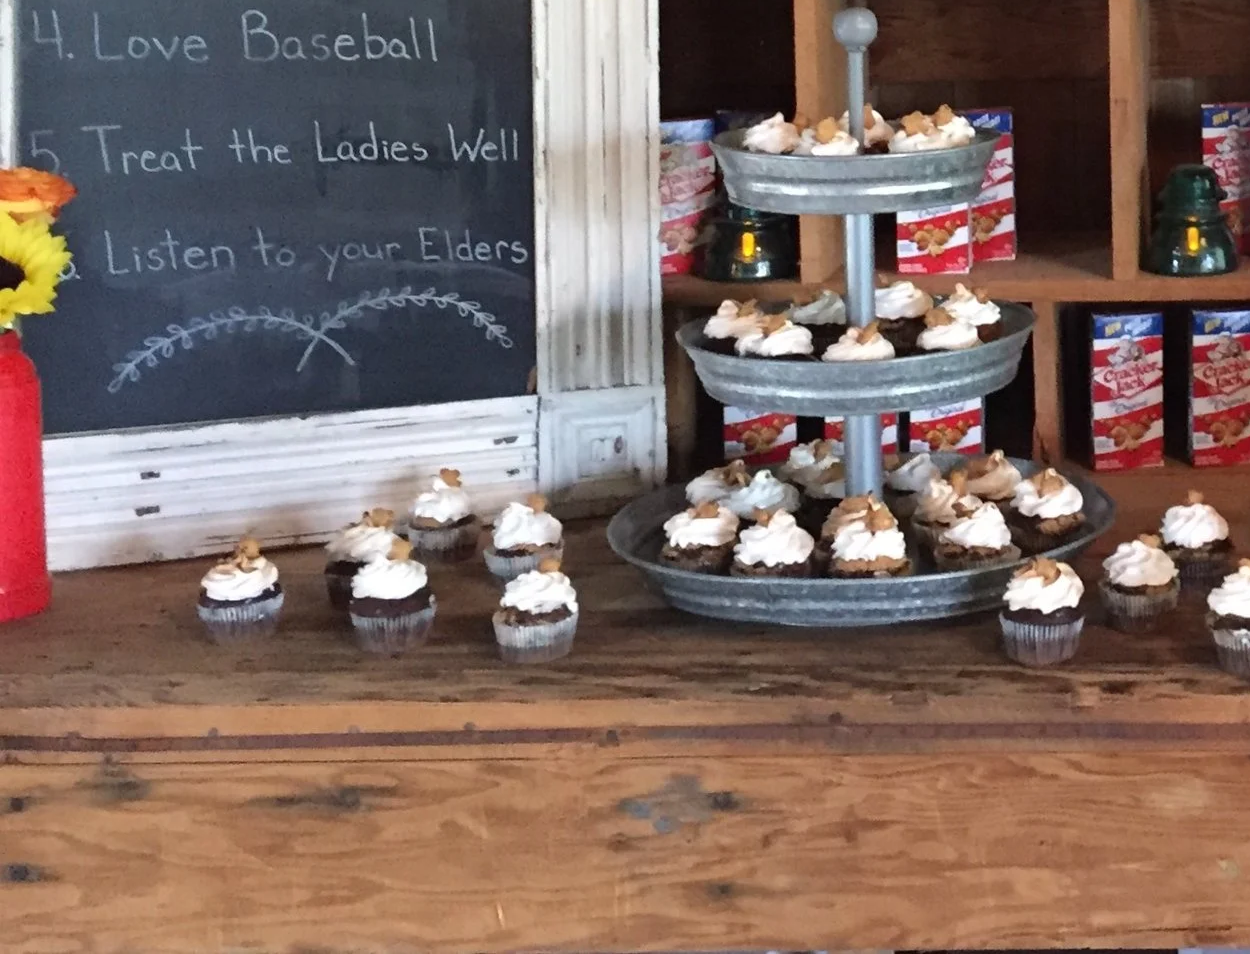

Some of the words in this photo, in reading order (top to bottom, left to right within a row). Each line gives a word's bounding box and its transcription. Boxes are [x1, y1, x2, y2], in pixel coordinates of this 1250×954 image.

[32, 11, 74, 59] 4.
[94, 12, 209, 61] Love
[241, 9, 438, 62] Baseball
[81, 124, 203, 174] Treat
[228, 128, 293, 165] the
[314, 120, 428, 164] Ladies
[447, 123, 518, 163] Well
[105, 229, 235, 275] Listen
[254, 226, 297, 268] to
[319, 240, 400, 282] your
[419, 227, 529, 264] Elders
[1104, 361, 1157, 383] Cracker
